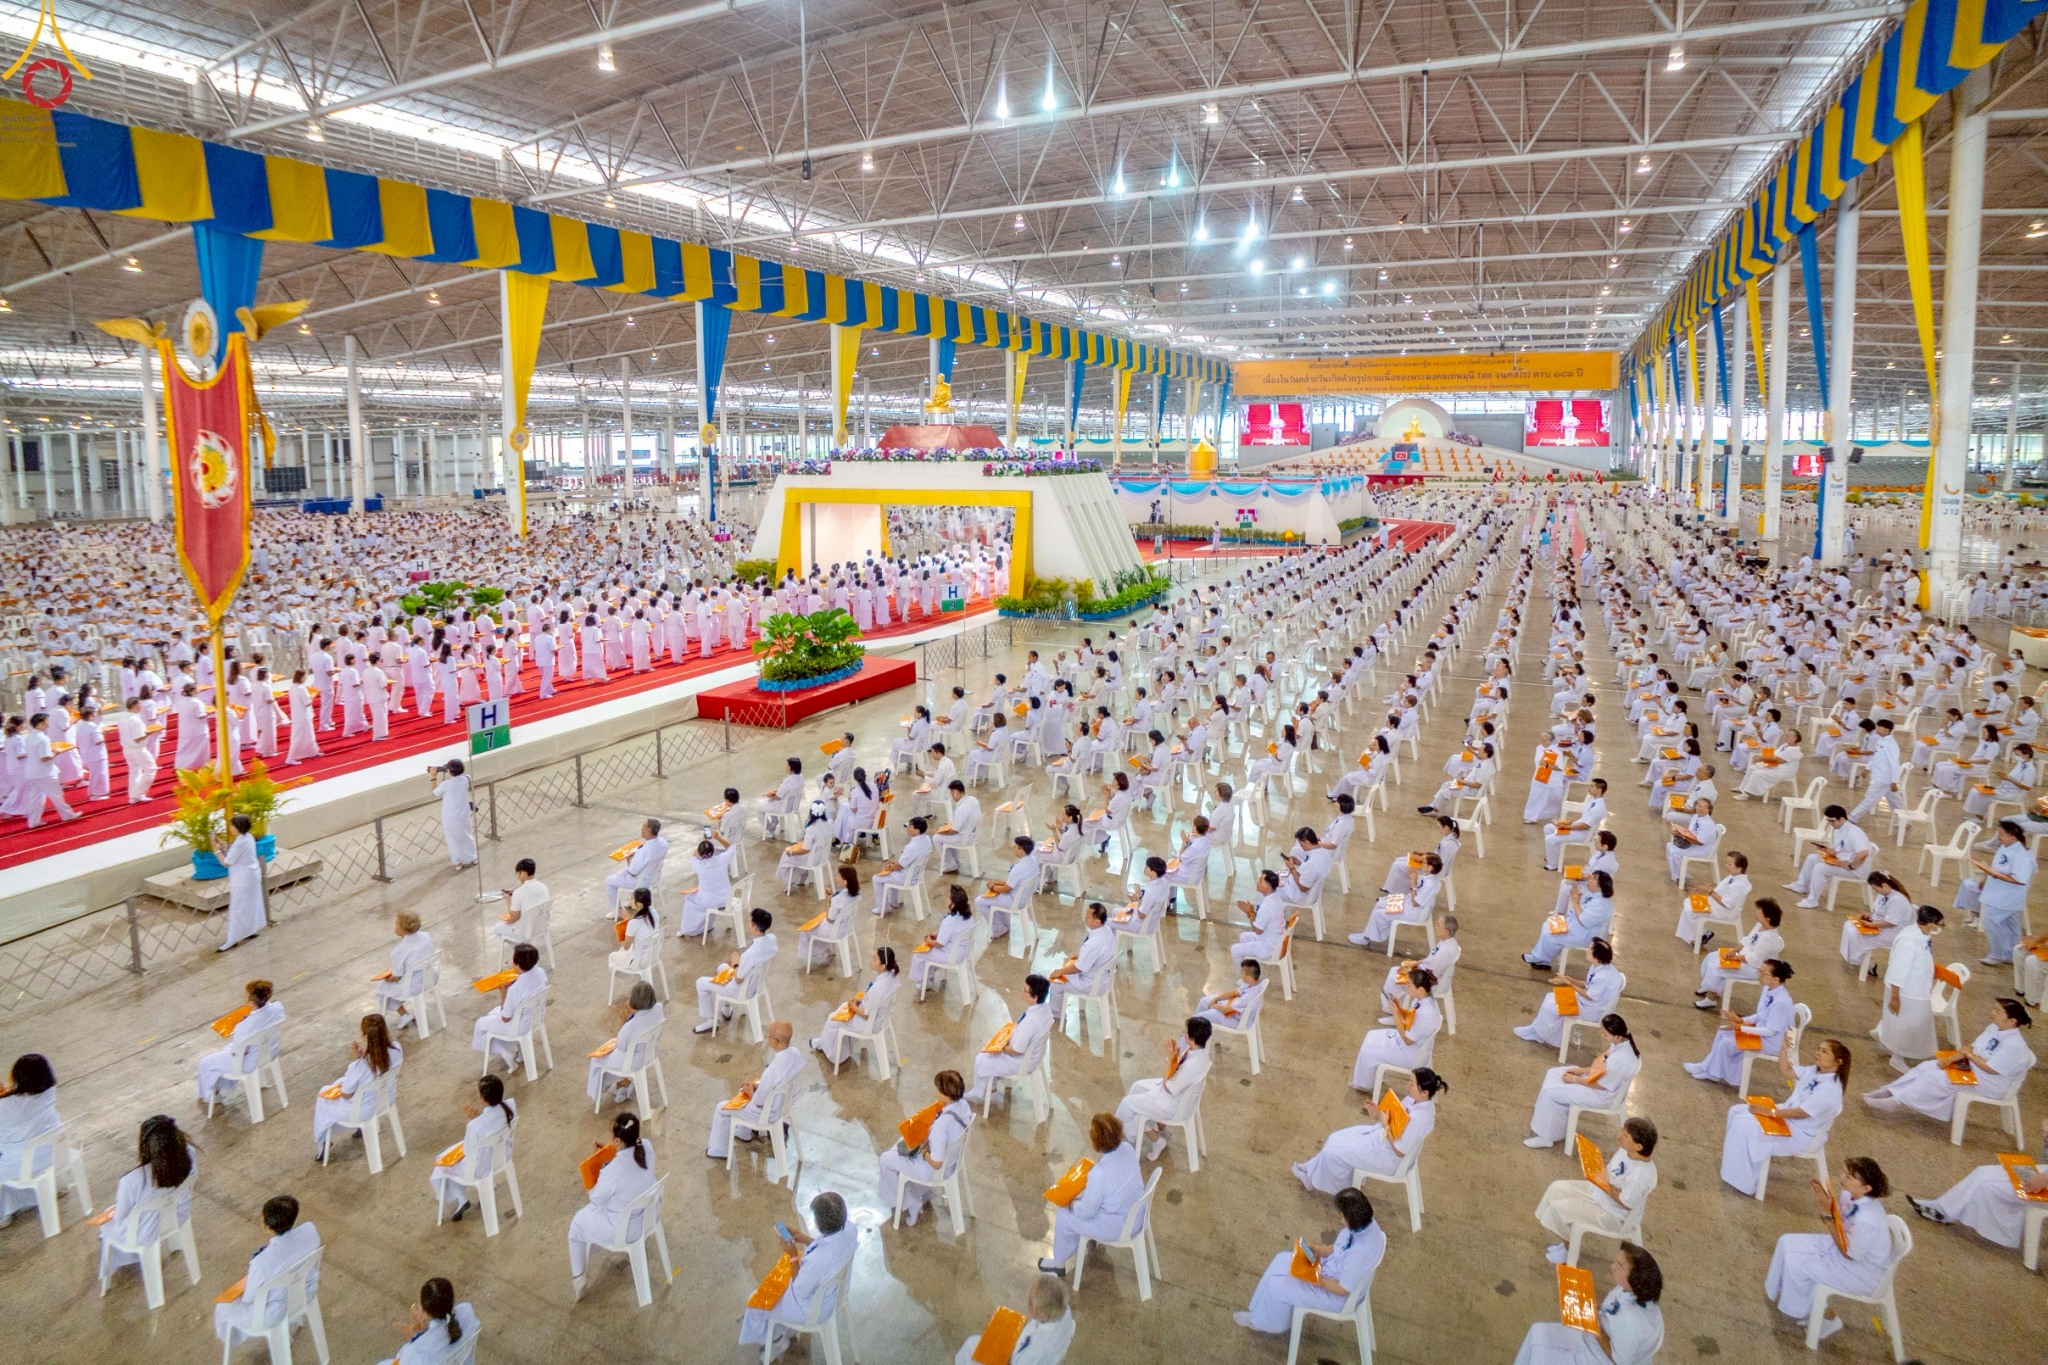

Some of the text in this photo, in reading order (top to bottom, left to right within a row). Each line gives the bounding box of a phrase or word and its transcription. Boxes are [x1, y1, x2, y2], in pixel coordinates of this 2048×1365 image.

[416, 561, 424, 571] H
[949, 586, 957, 599] H
[481, 704, 497, 729] H
[484, 731, 494, 750] 7
